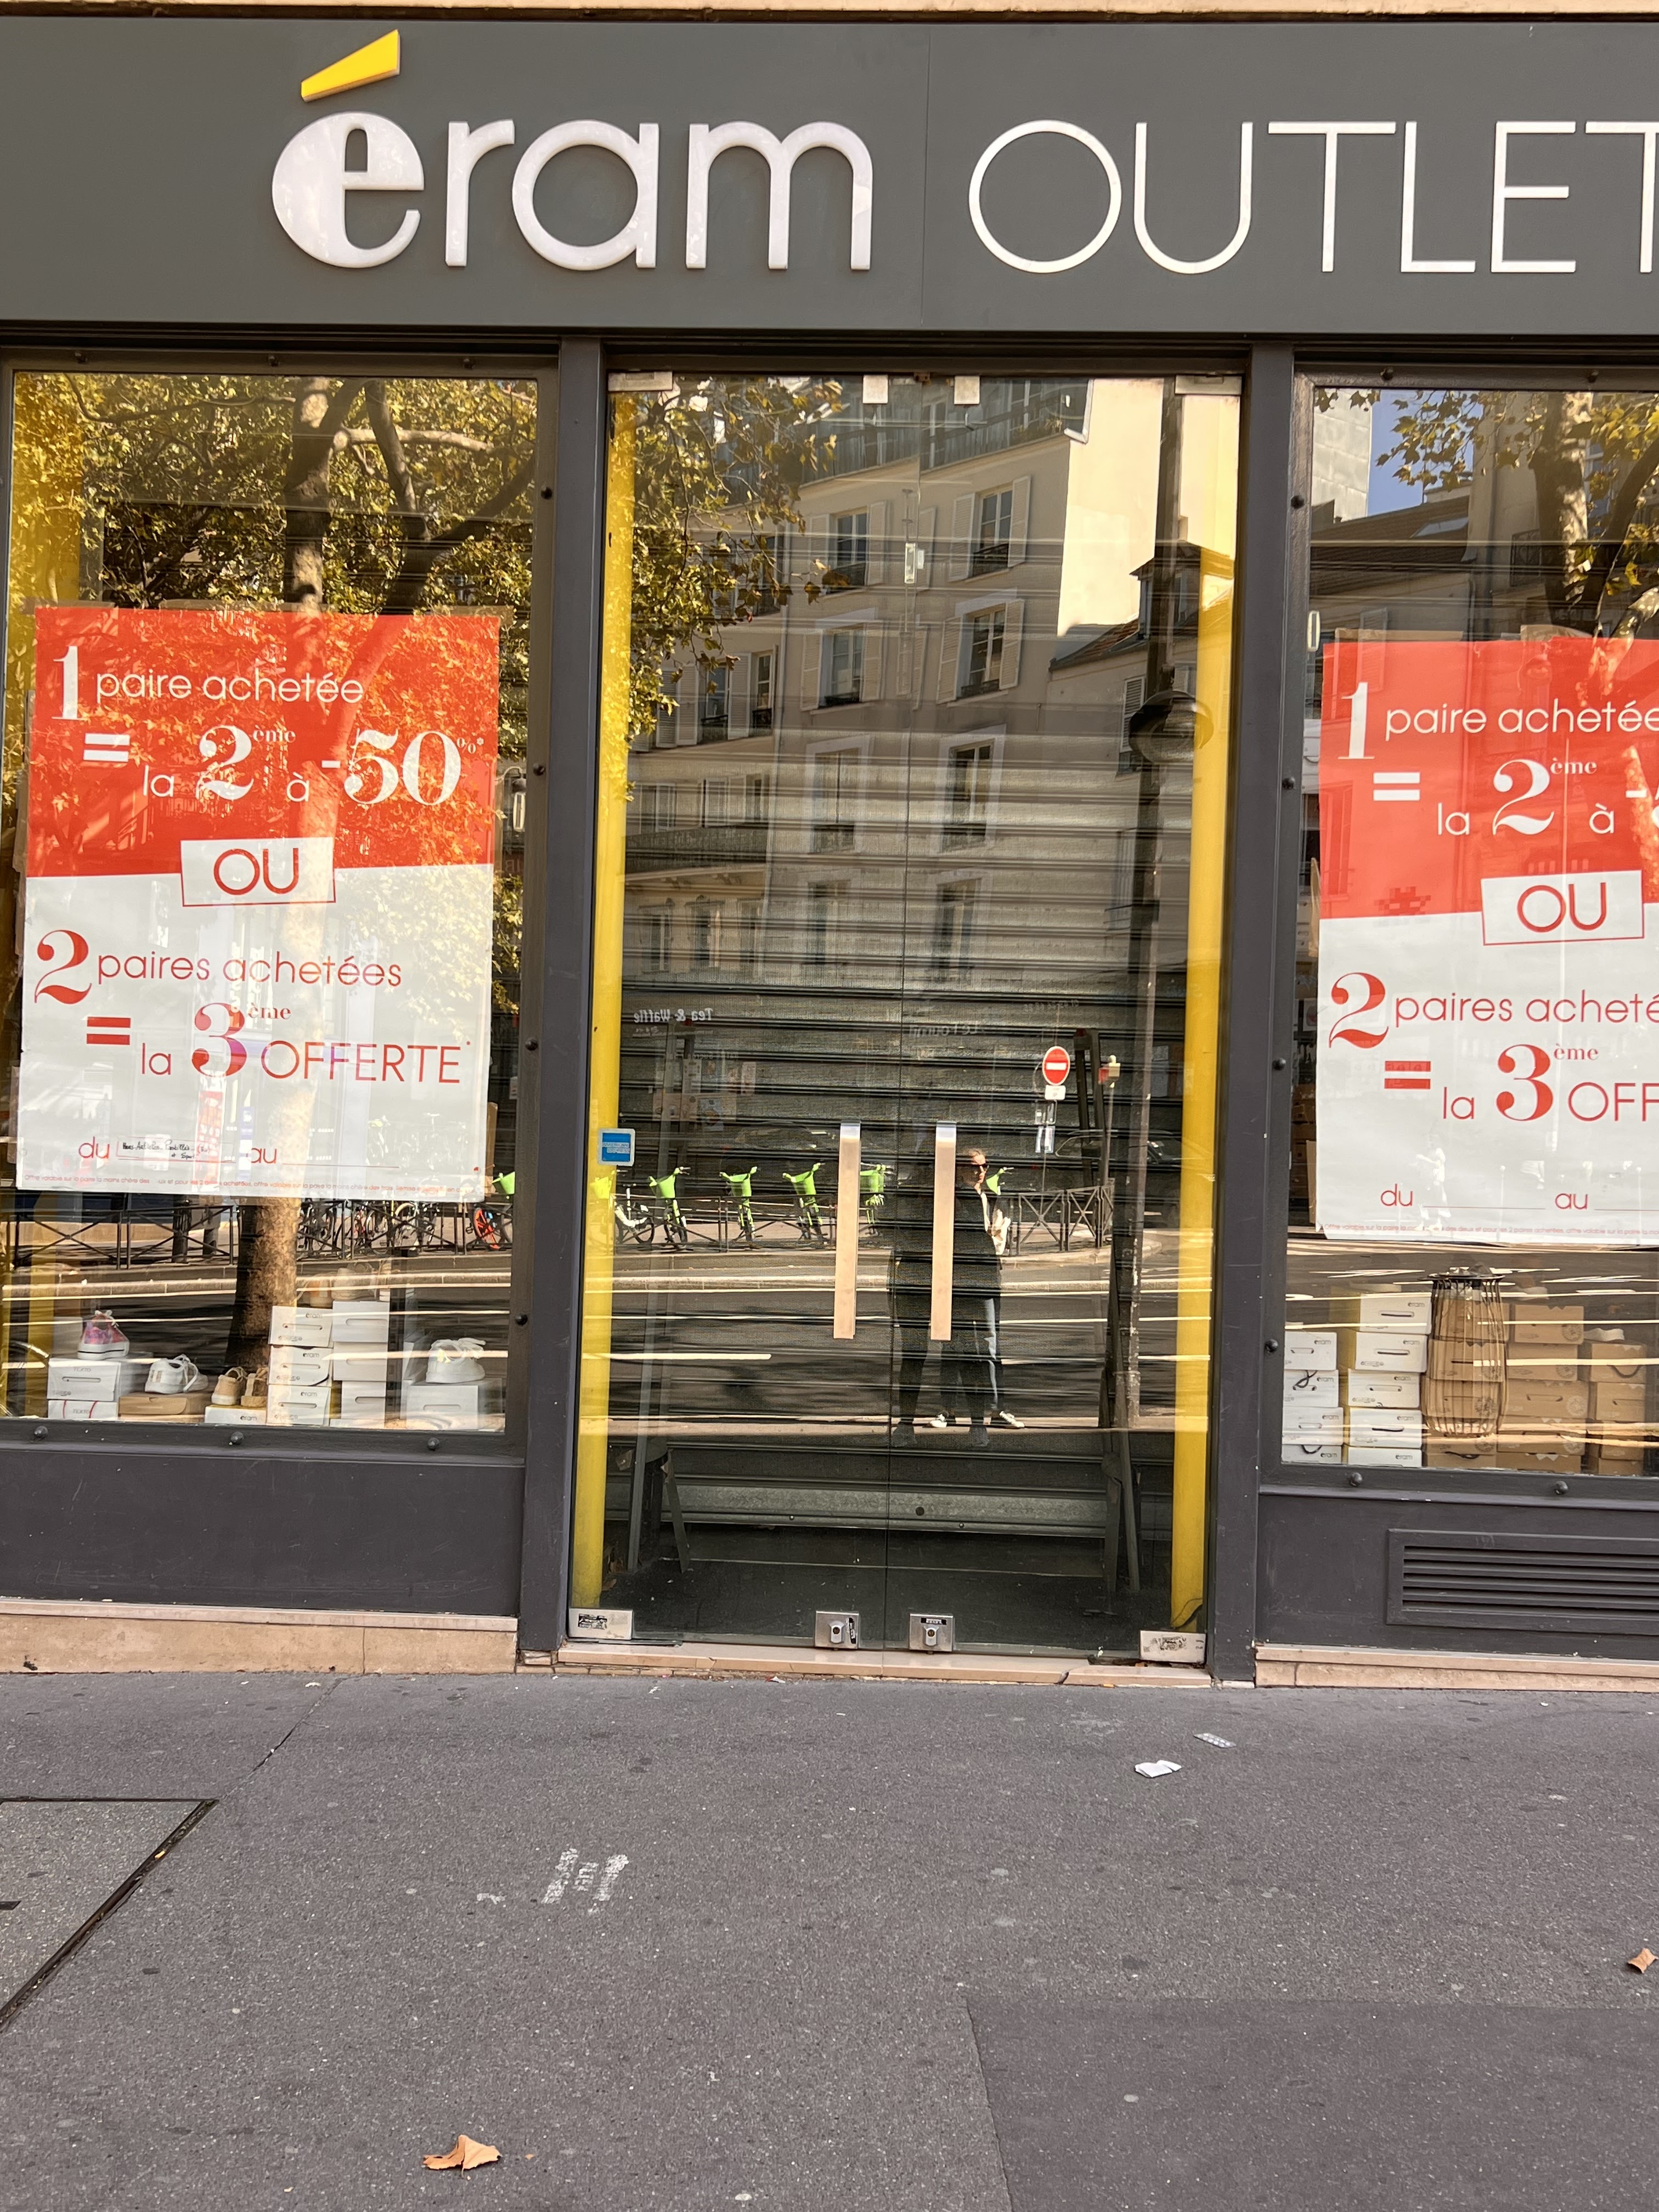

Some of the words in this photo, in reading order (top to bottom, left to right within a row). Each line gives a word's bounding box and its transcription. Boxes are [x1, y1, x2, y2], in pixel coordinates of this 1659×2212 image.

[272, 29, 872, 272] éram
[969, 120, 1659, 274] OUTLET
[52, 645, 81, 720] 1
[97, 673, 192, 704] paire
[202, 667, 364, 704] achetée
[1338, 682, 1375, 759] 1
[1385, 703, 1487, 741] paire
[143, 766, 174, 798] la
[286, 774, 310, 803] à
[1437, 803, 1470, 835] la
[1589, 803, 1615, 834] à
[213, 848, 299, 896] OU
[1517, 882, 1606, 932] OU
[34, 929, 92, 1005] 2
[98, 951, 210, 985] paires
[223, 951, 402, 986] achetées
[1329, 972, 1389, 1048] 2
[1396, 993, 1512, 1028] paires
[142, 1042, 171, 1075] la
[1443, 1087, 1475, 1119] la
[1567, 1082, 1659, 1121] OFF
[78, 1136, 110, 1159] du
[247, 1147, 278, 1164] au
[1380, 1183, 1413, 1207] du
[1554, 1193, 1588, 1210] au
